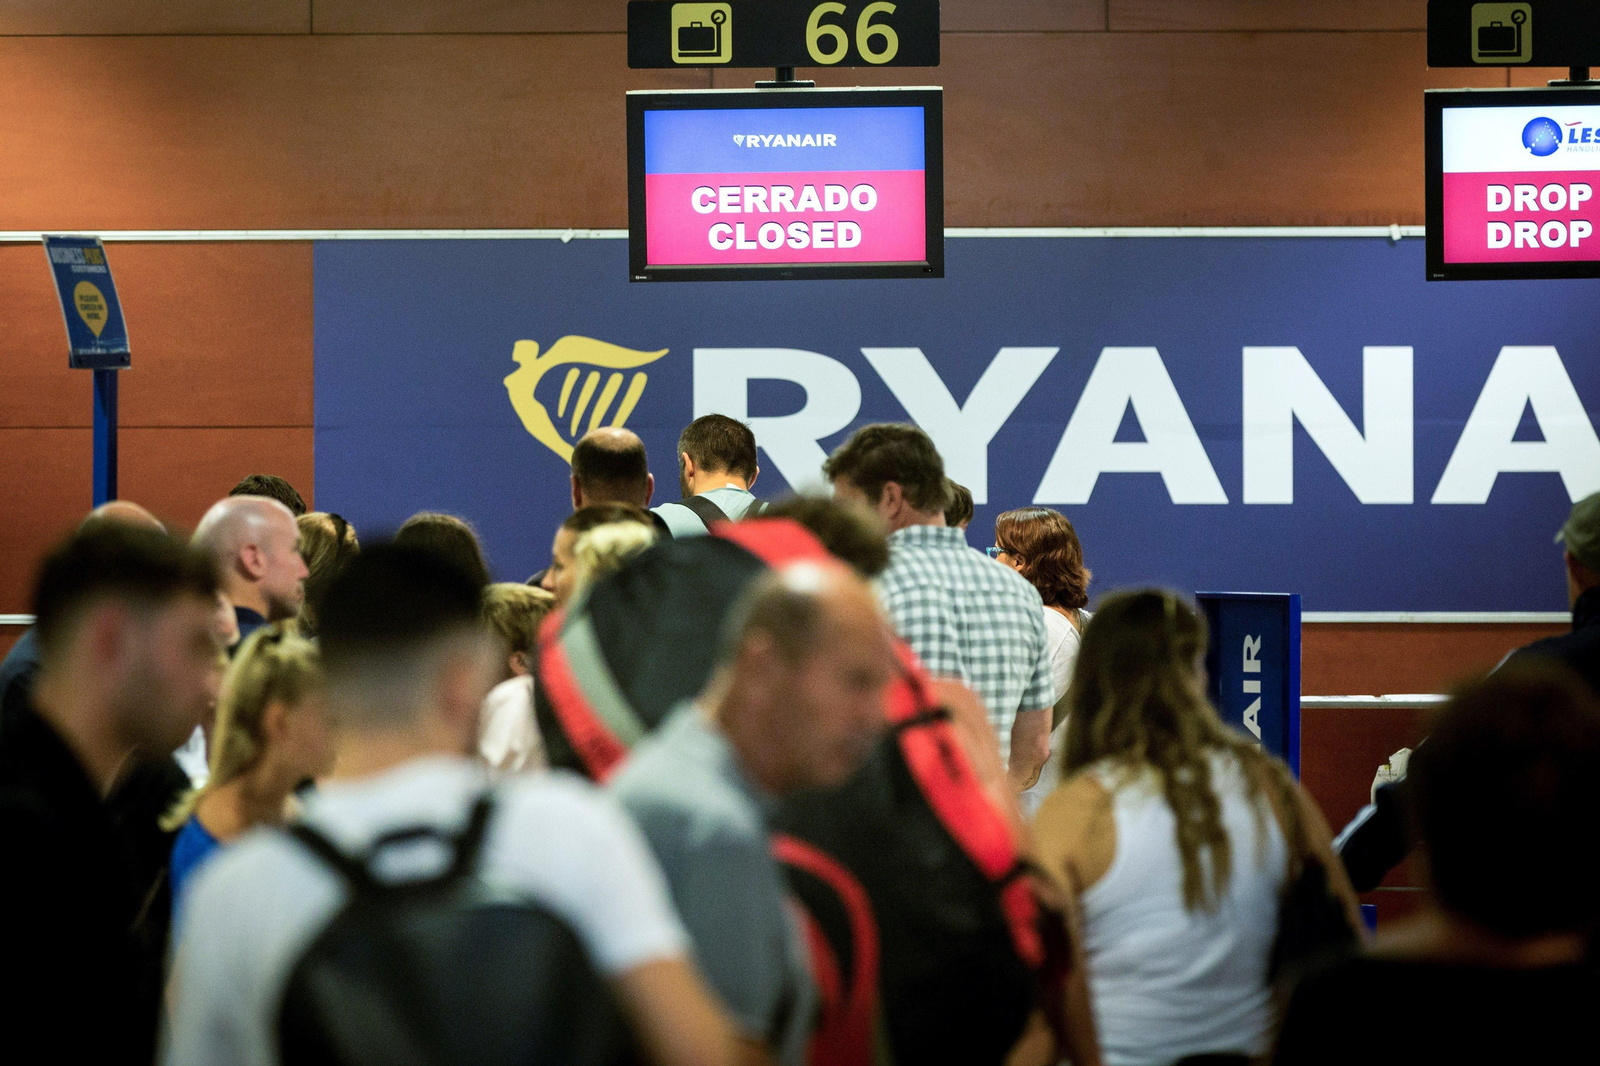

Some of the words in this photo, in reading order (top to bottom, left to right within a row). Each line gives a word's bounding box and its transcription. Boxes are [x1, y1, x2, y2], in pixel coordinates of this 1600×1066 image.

[805, 1, 899, 65] 66
[746, 133, 837, 148] RYANAIR
[691, 183, 878, 214] CERRADO
[1487, 182, 1593, 213] DROP
[708, 221, 862, 251] CLOSED
[1487, 219, 1593, 249] DROP
[693, 346, 1600, 505] RYANA
[1243, 634, 1261, 752] AIR
